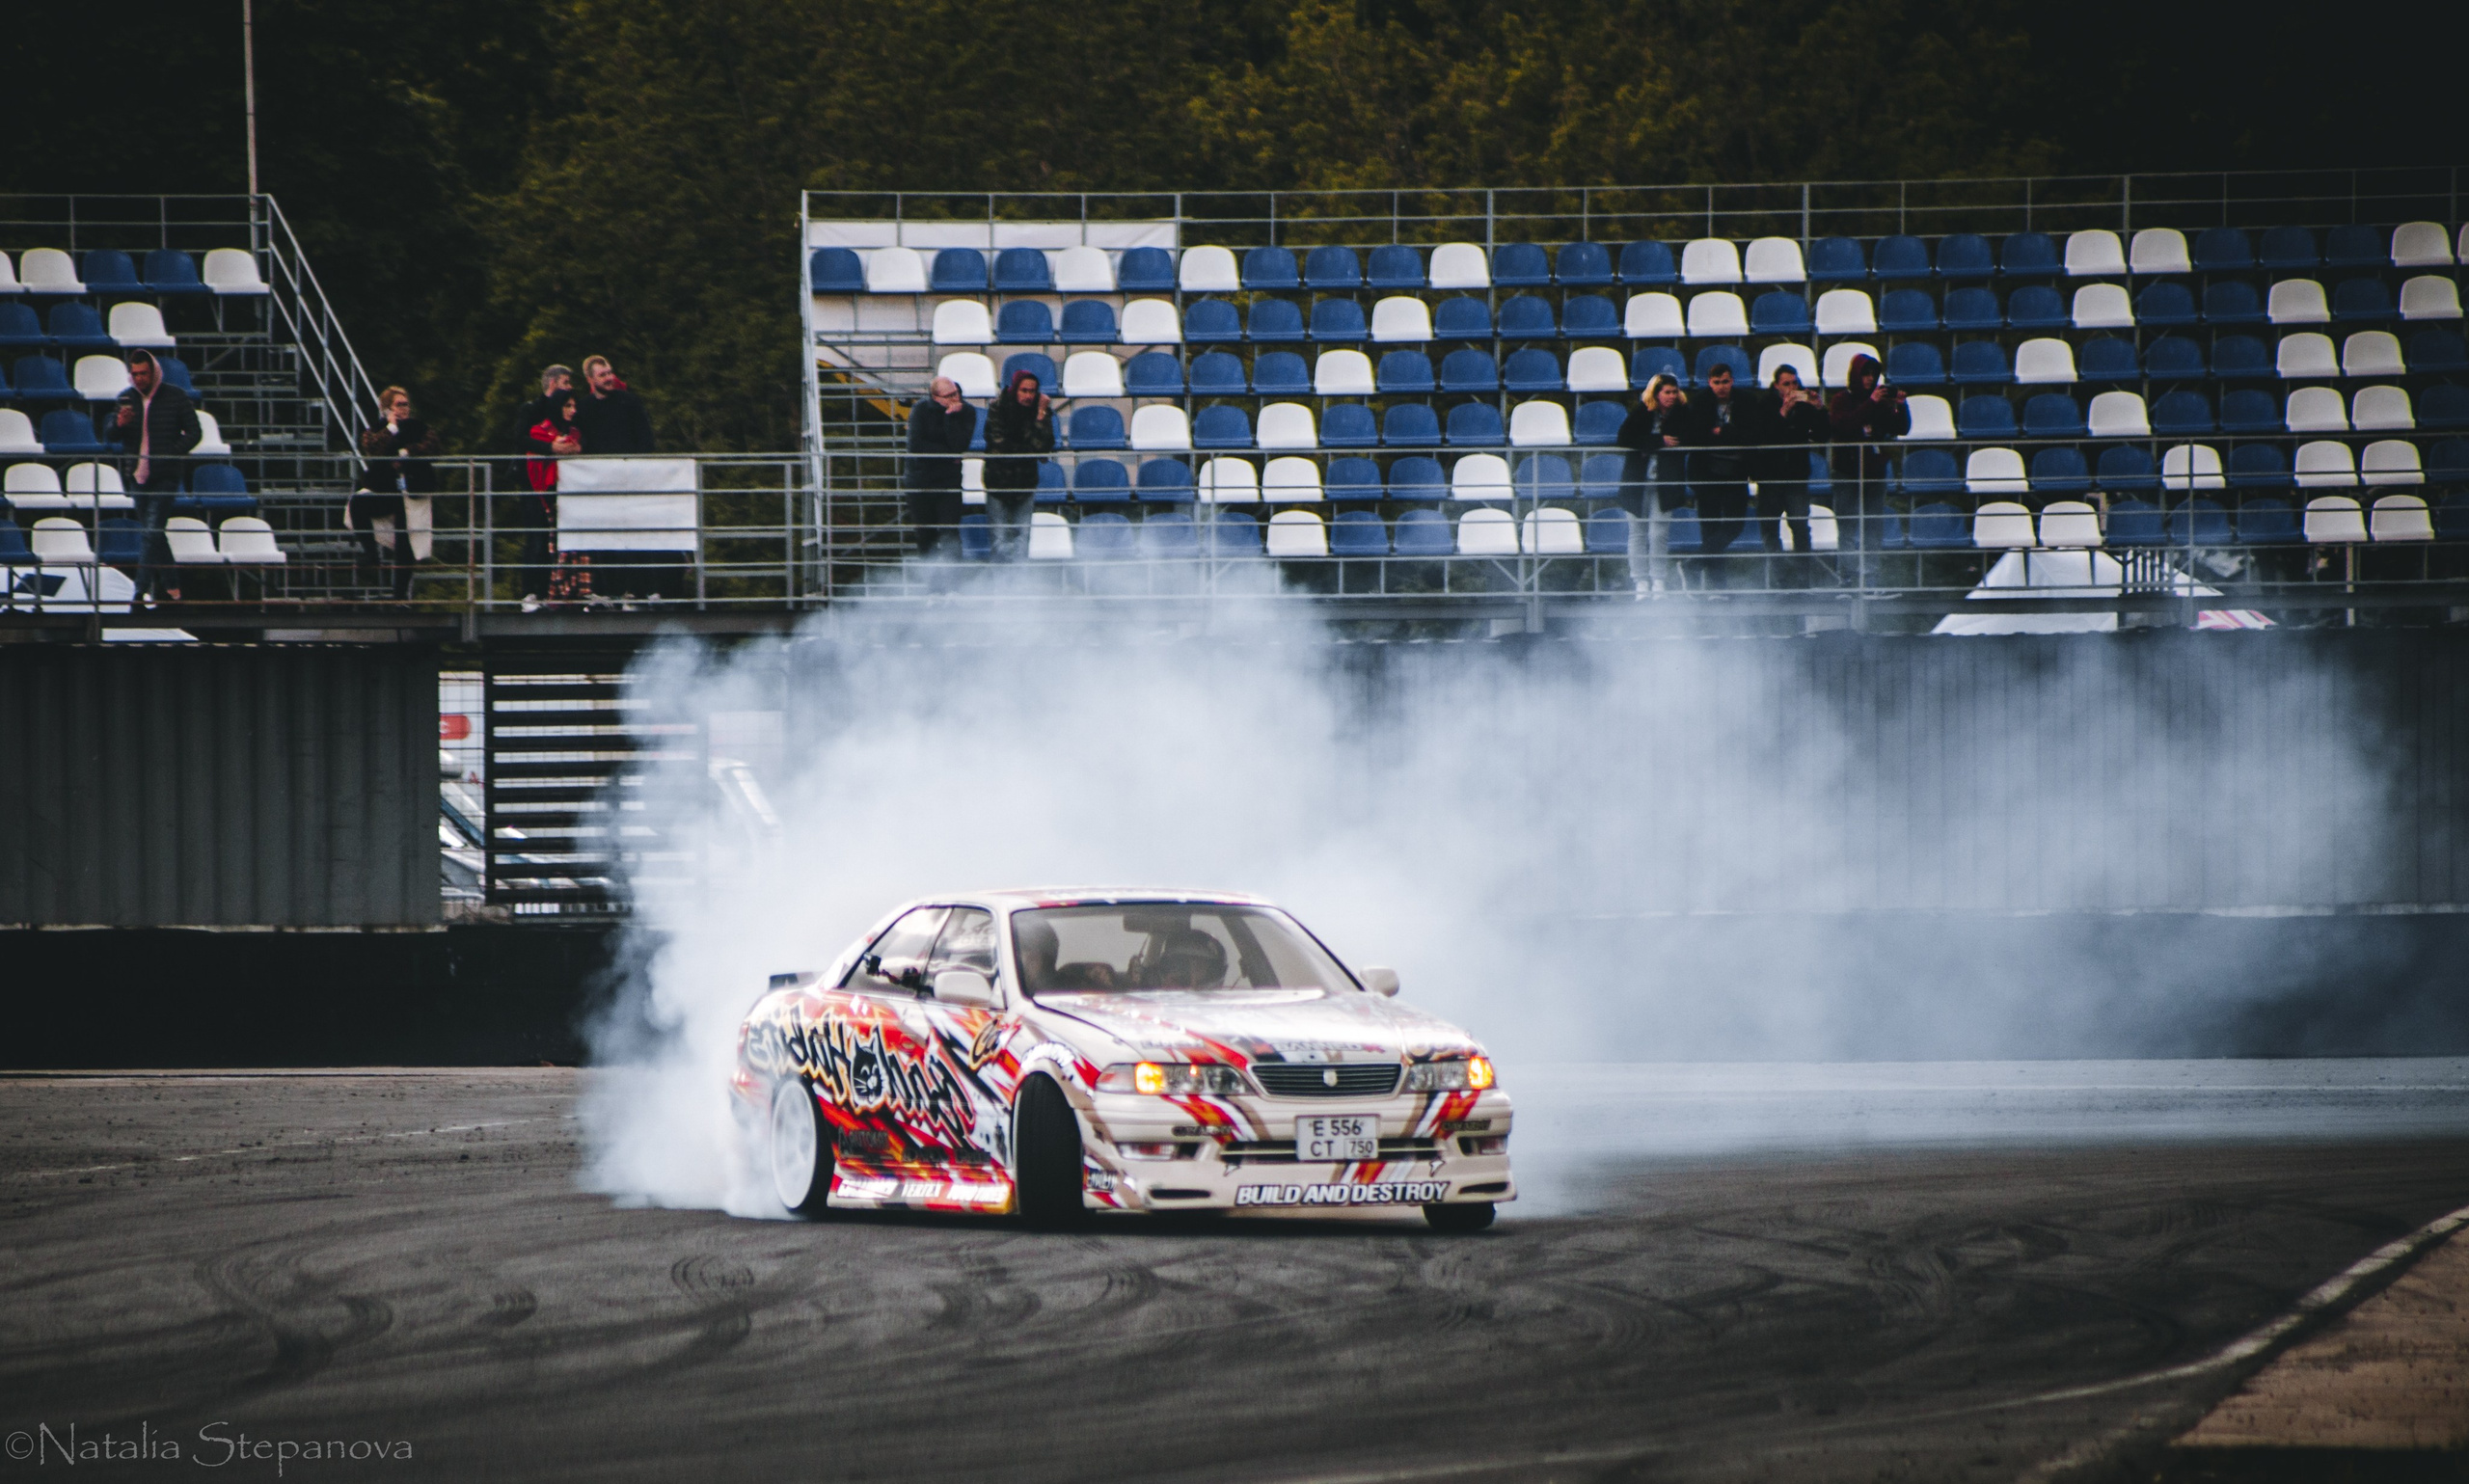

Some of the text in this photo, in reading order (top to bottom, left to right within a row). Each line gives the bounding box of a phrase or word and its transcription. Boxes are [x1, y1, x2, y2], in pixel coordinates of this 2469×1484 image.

[1313, 1120, 1362, 1136] E 556
[1311, 1140, 1373, 1157] CT 750
[901, 1180, 943, 1198] VERTEX
[1236, 1182, 1449, 1204] BUILD AND DESTROY
